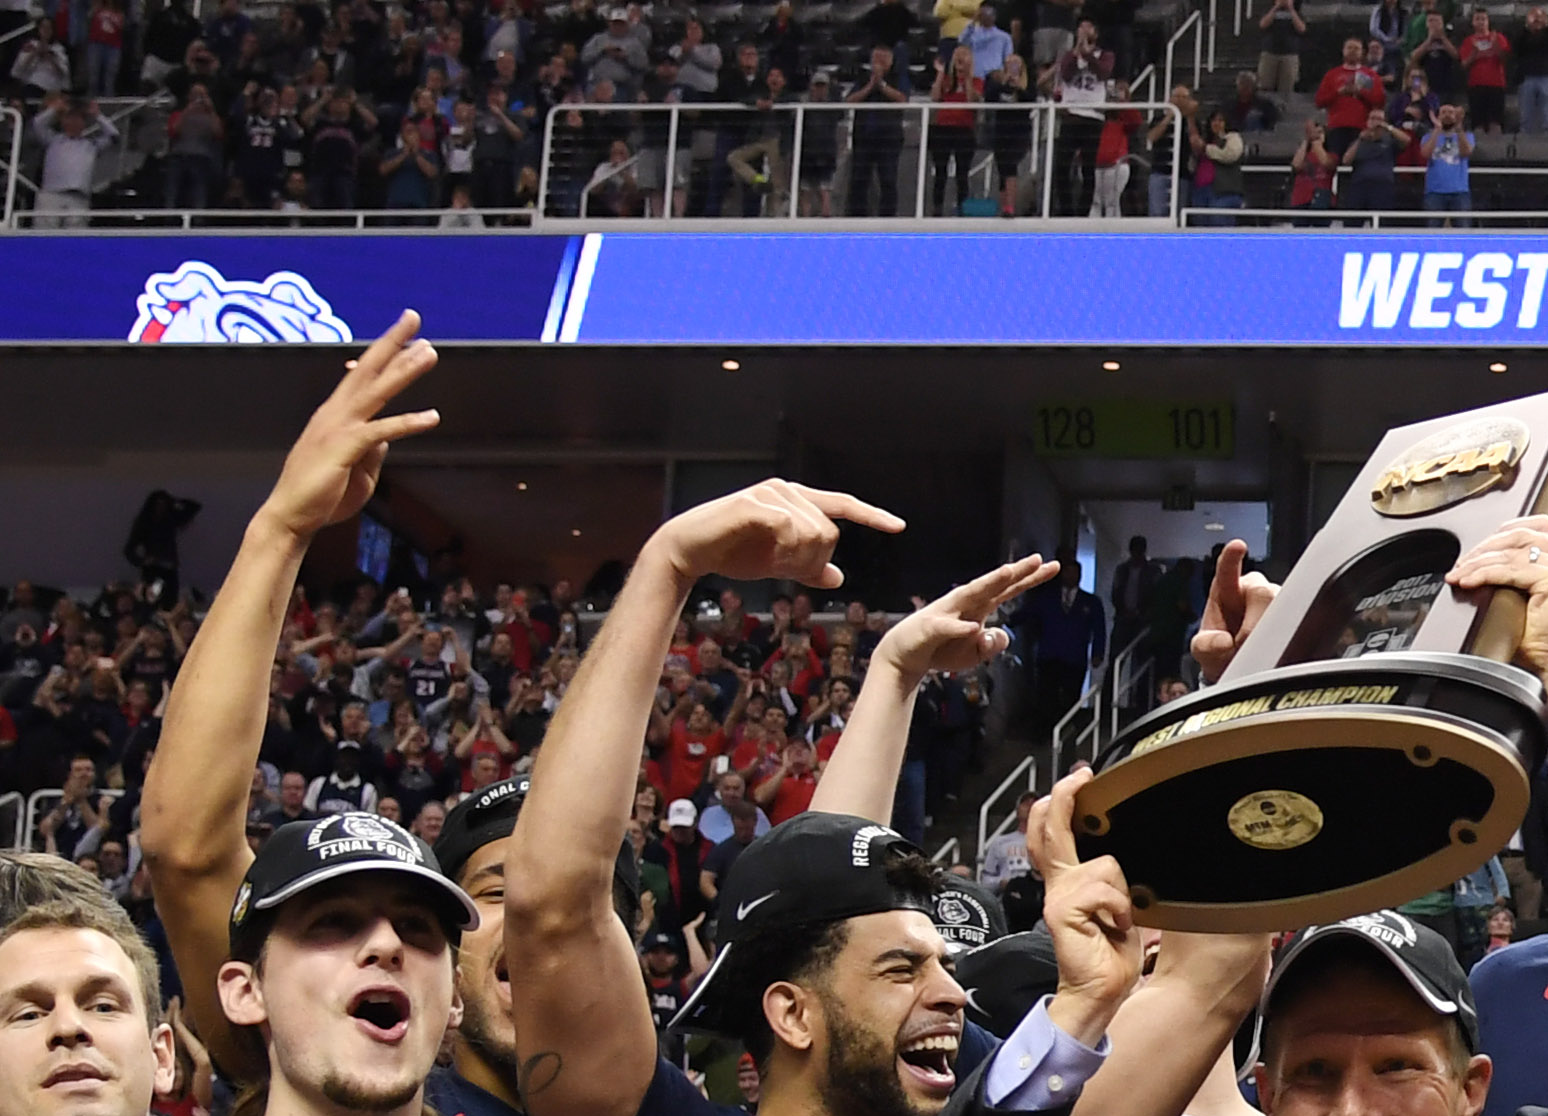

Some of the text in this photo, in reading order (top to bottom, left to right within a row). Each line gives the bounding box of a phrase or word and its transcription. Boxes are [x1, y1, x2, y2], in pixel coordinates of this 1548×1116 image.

[1037, 407, 1221, 449] 128 101
[1371, 441, 1512, 501] NCAA
[1354, 581, 1444, 611] DIVISION
[416, 679, 436, 696] 21
[1178, 696, 1275, 733] REGIONAL
[1275, 686, 1399, 710] CHAMPION
[475, 783, 517, 808] ONAL
[319, 839, 416, 865] FINAL FOUR
